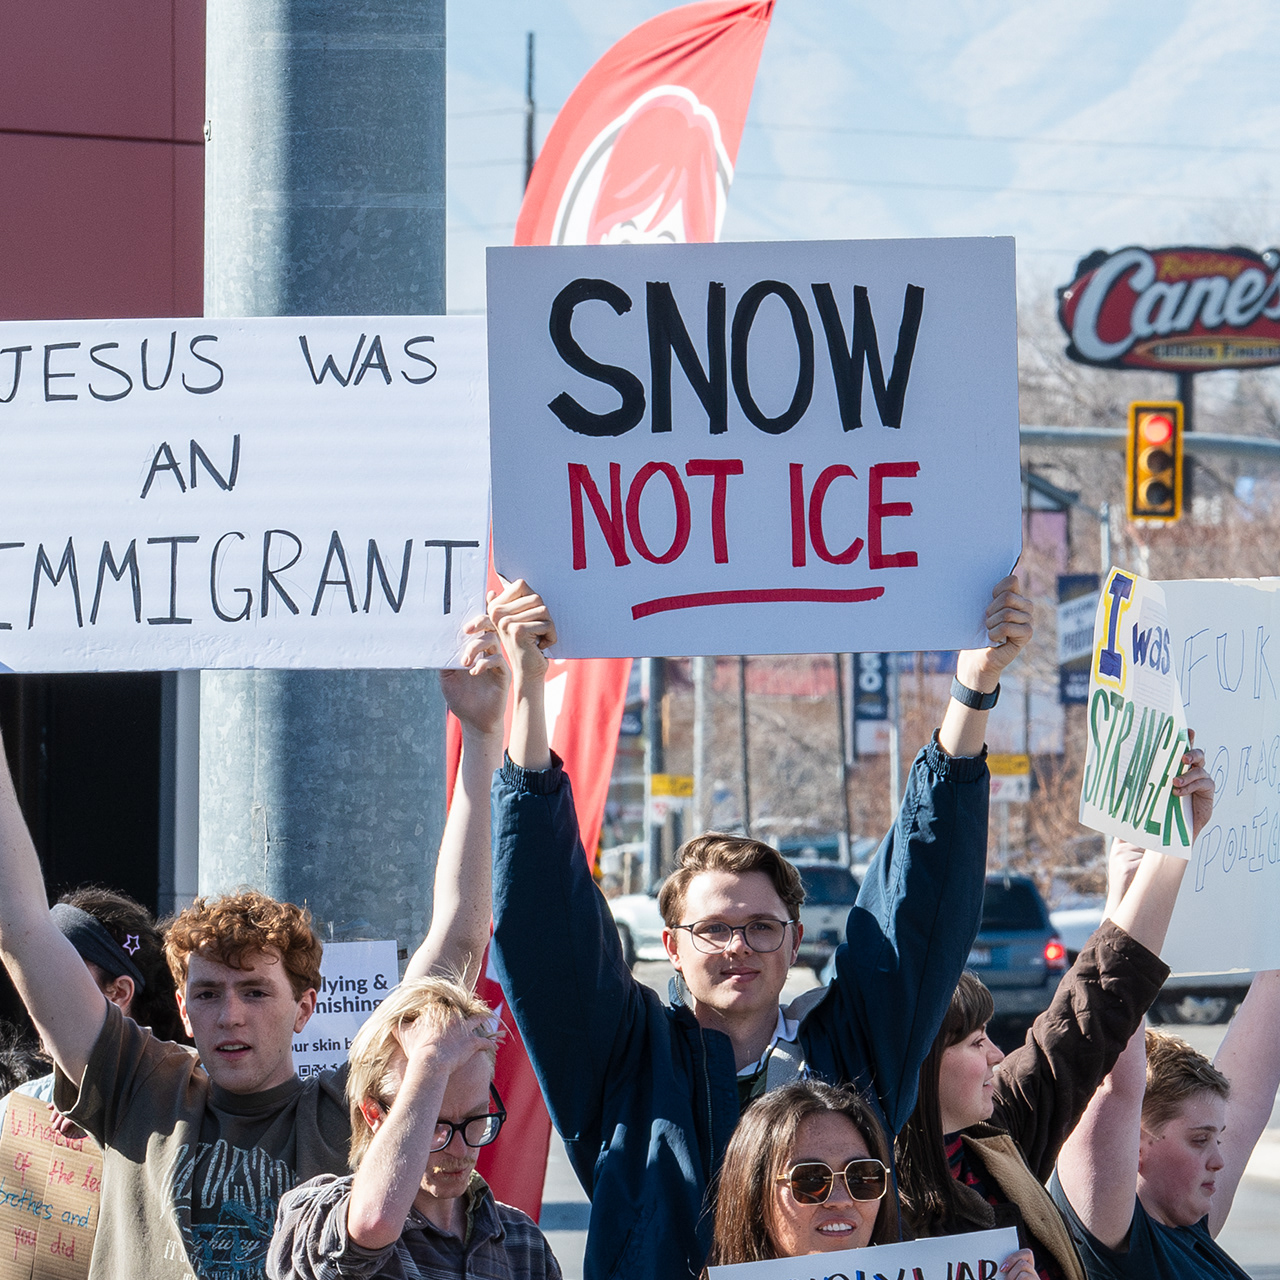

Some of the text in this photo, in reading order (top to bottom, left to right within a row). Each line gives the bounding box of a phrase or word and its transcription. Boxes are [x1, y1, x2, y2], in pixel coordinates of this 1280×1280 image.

[299, 335, 437, 387] WAS
[548, 278, 925, 436] SNOW
[141, 434, 241, 499] AN
[568, 459, 921, 571] NOT ICE
[1099, 572, 1171, 681] I was
[1084, 688, 1191, 848] STRANGER
[321, 973, 389, 996] lying &
[312, 1038, 341, 1052] skin
[13, 1151, 32, 1186] of
[48, 1157, 75, 1185] the
[61, 1205, 91, 1229] and
[14, 1225, 76, 1262] you did
